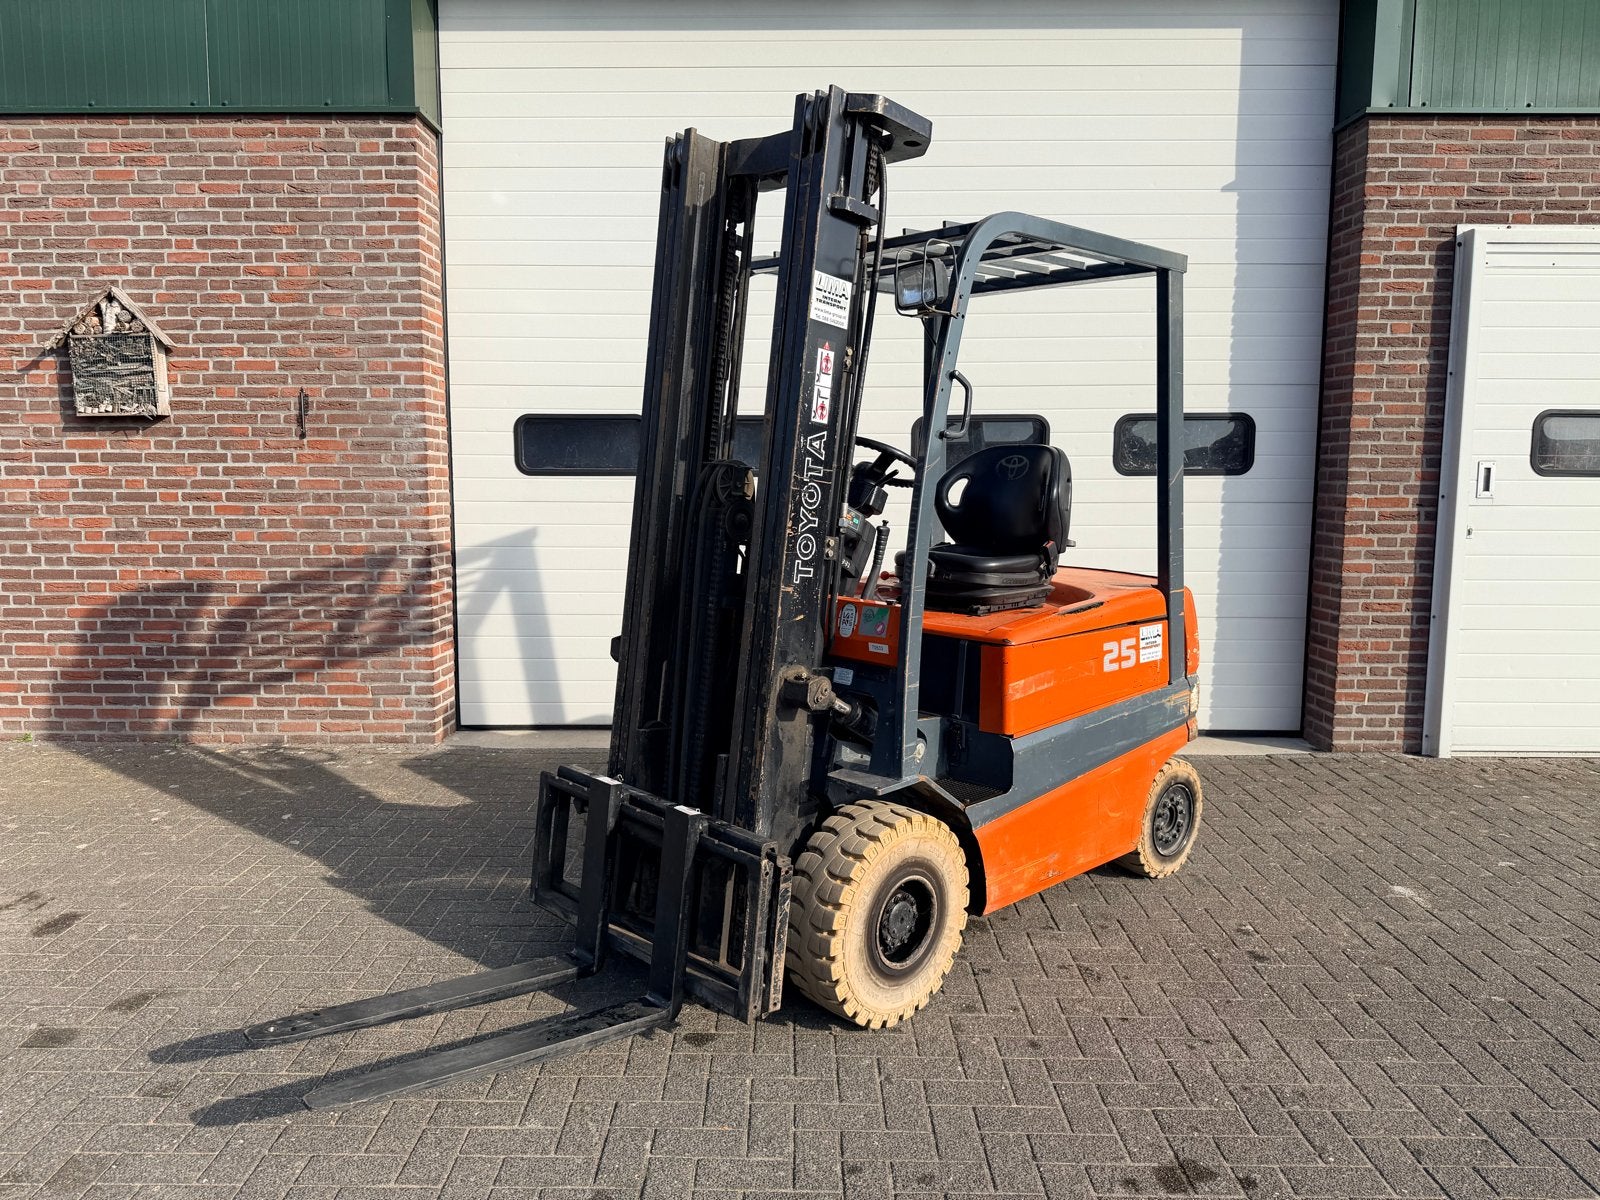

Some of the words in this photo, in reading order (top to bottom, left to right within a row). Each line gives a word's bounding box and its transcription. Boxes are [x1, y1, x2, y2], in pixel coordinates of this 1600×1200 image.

[815, 273, 849, 300] LIMA
[822, 295, 841, 304] INTERN
[816, 298, 846, 311] TRANSPORT
[794, 431, 827, 583] TOYOTA
[1103, 637, 1137, 673] 25
